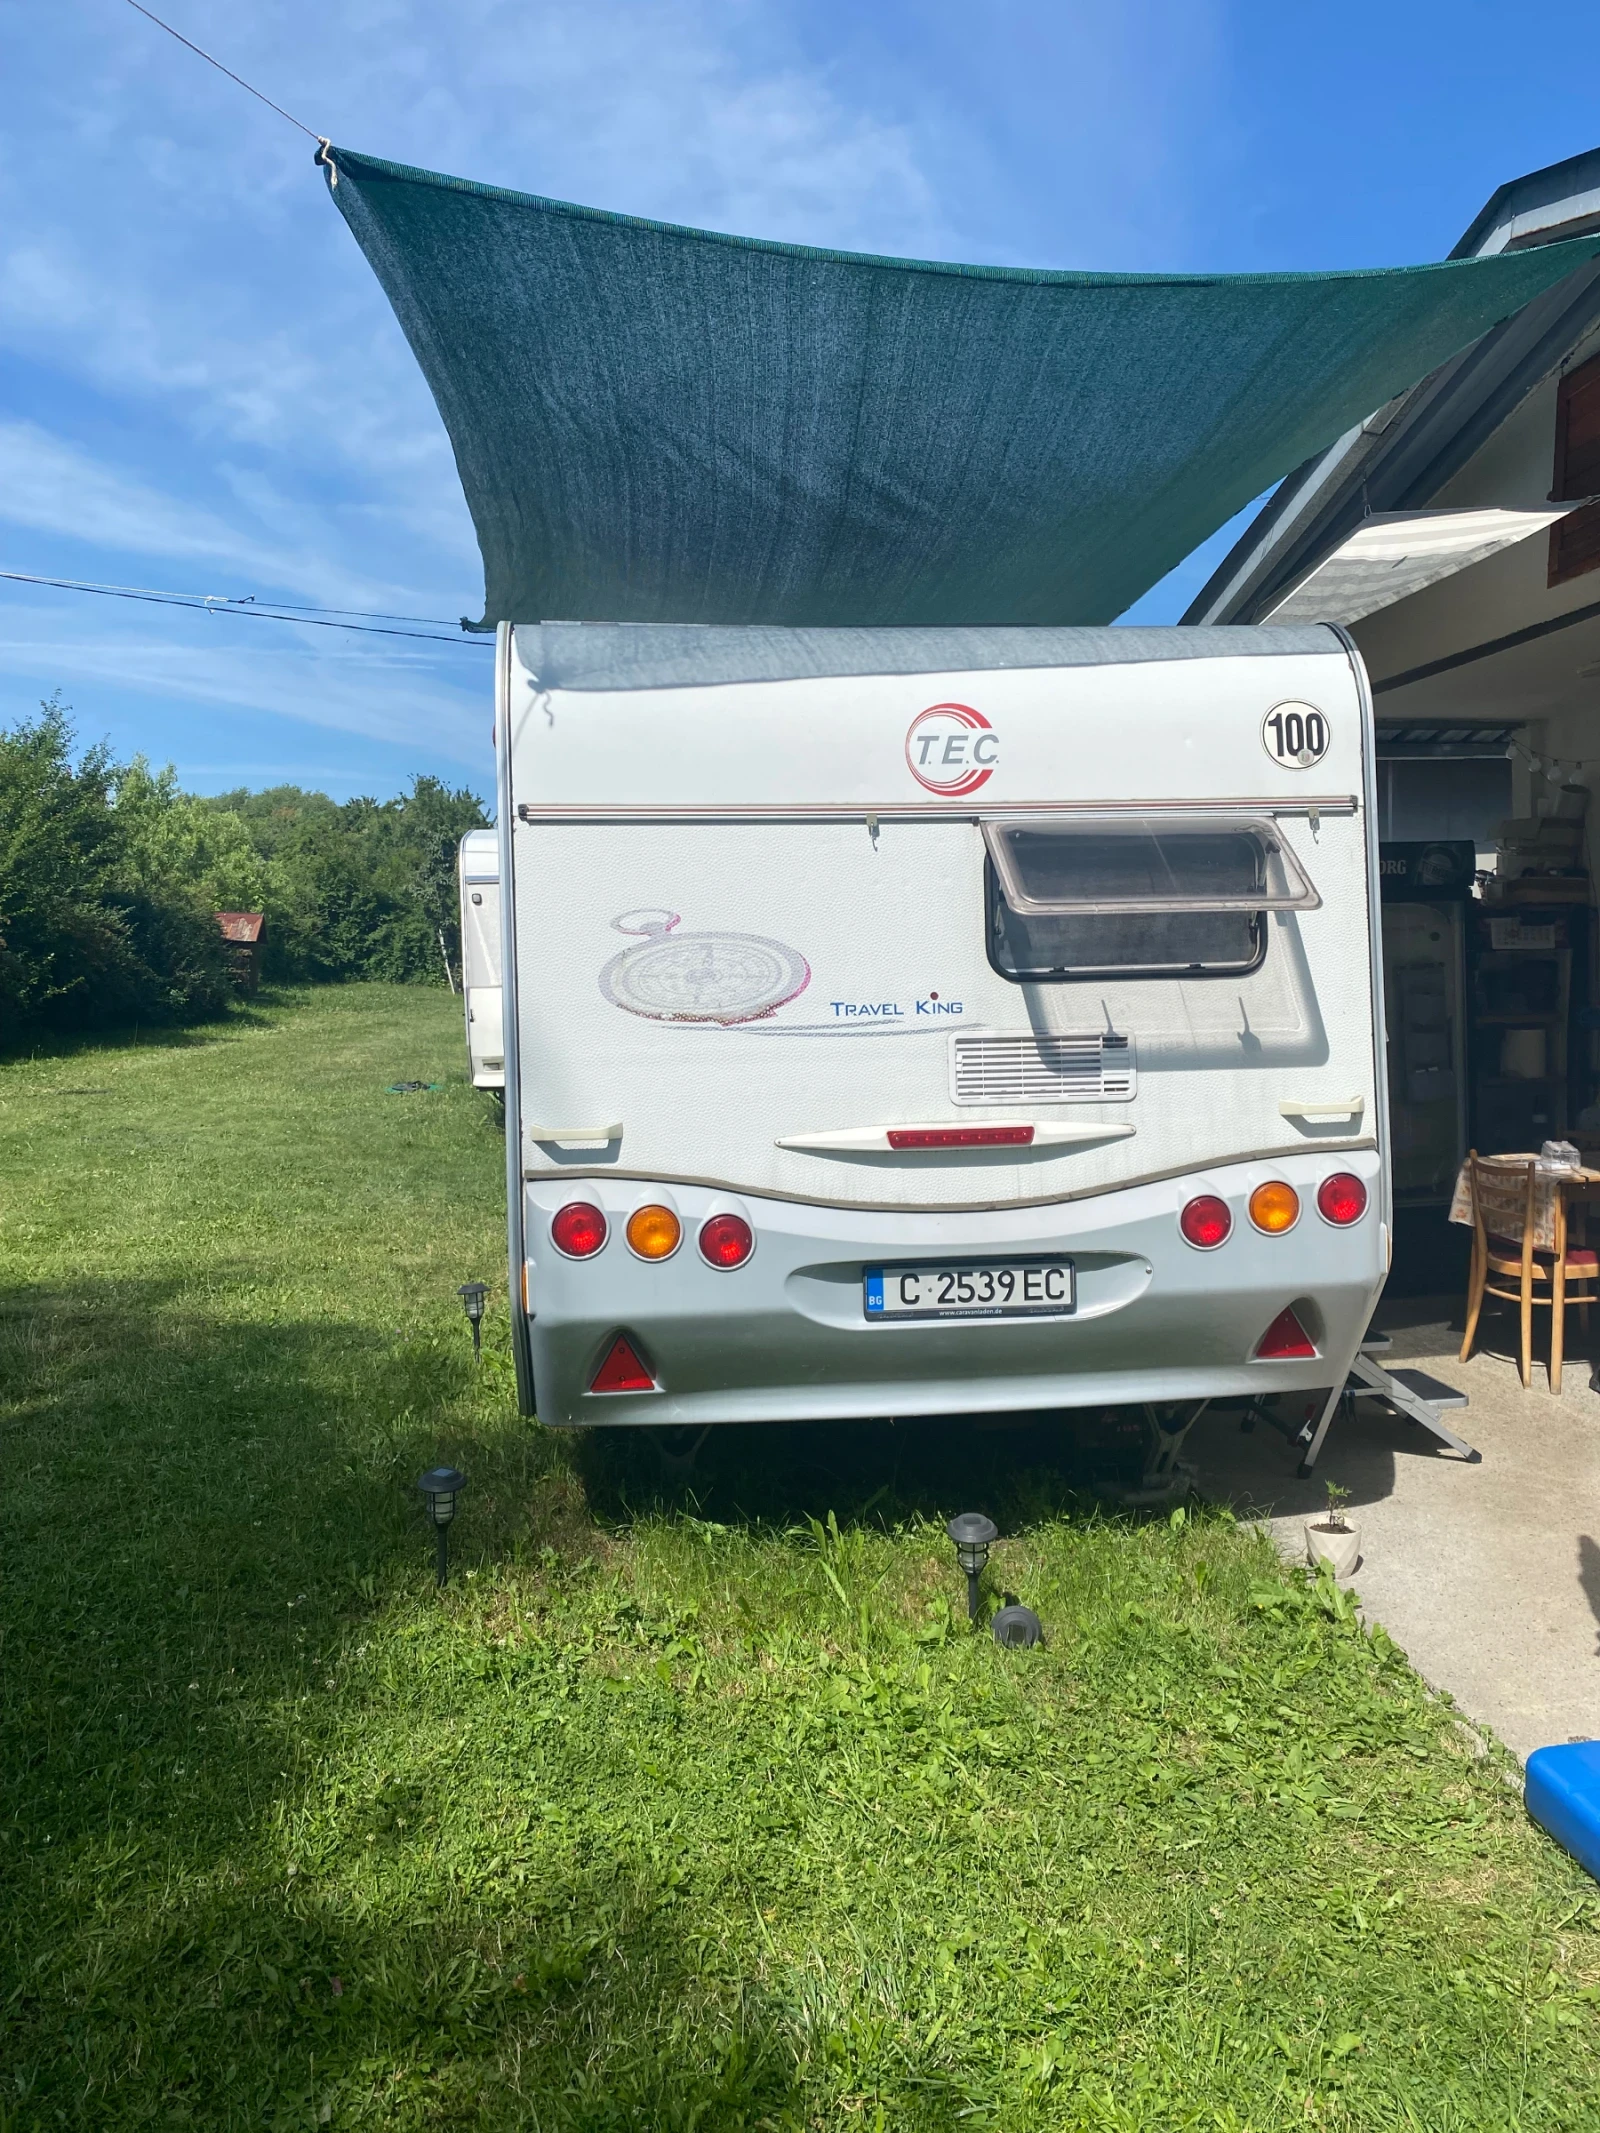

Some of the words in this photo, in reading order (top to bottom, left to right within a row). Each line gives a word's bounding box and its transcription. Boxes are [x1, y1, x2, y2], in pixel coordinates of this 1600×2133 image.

[1267, 712, 1324, 757] 100
[916, 734, 1000, 765] T.E.C.
[830, 1002, 904, 1017] TRAVEL
[899, 1273, 920, 1305] C
[937, 1270, 1016, 1304] 2539
[1023, 1268, 1065, 1301] EC
[868, 1296, 882, 1306] BG
[938, 1307, 1003, 1316] www.caravanladen.de
